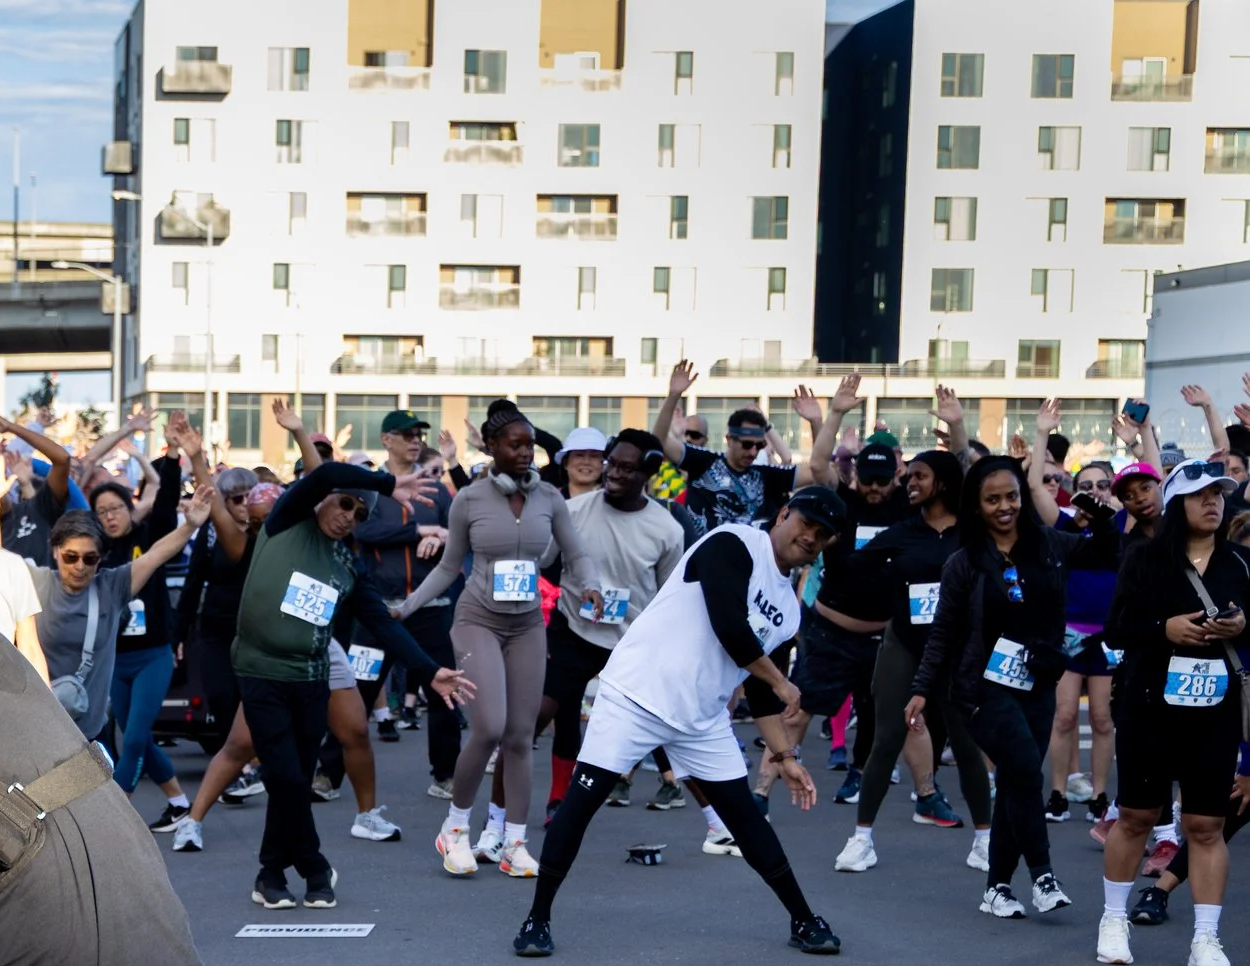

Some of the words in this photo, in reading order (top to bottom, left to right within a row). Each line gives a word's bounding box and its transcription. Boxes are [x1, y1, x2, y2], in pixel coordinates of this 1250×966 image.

[503, 573, 530, 592] 573
[294, 588, 327, 616] 525
[918, 597, 940, 616] 27
[351, 656, 375, 674] 407
[1177, 674, 1217, 697] 286
